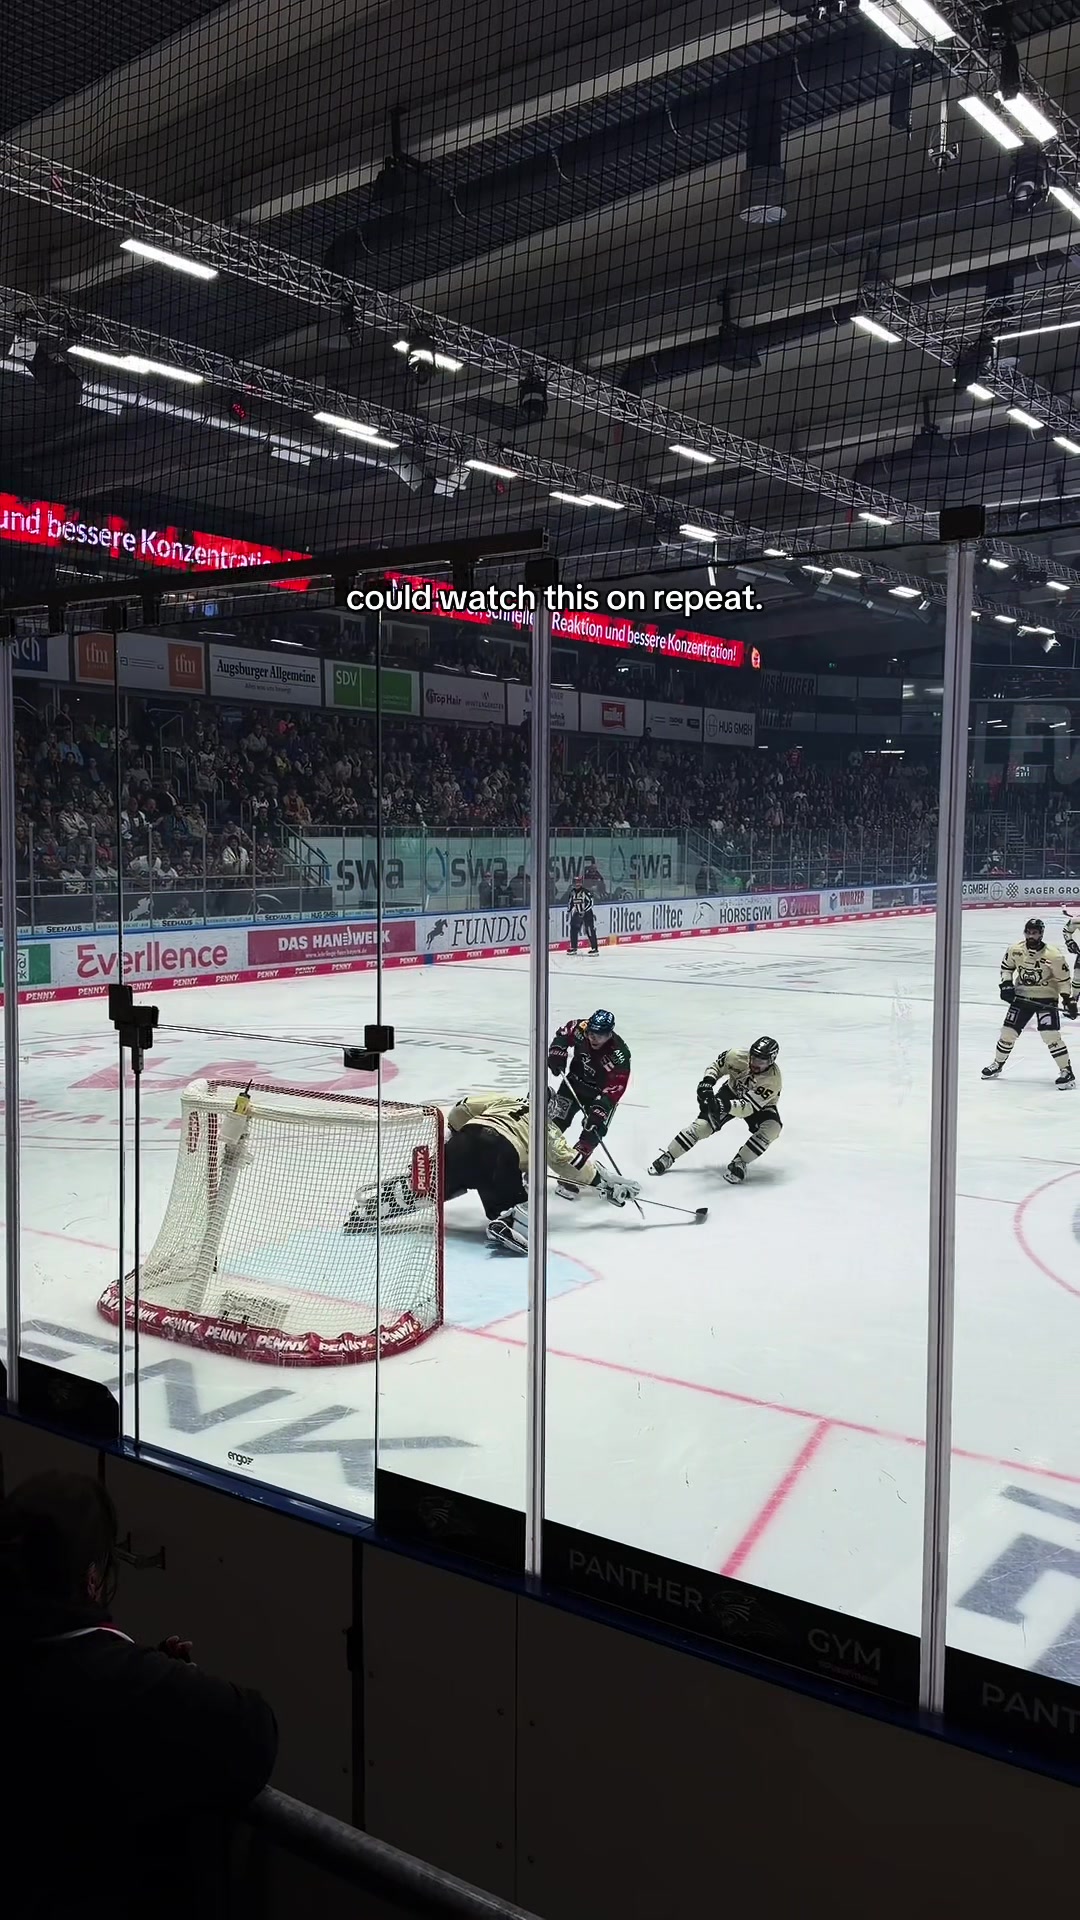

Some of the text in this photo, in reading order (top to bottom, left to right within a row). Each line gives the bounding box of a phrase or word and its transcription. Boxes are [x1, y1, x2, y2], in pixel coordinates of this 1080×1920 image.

[48, 510, 136, 551] bessere
[141, 529, 272, 569] Konzentrati
[551, 612, 603, 638] Reaktion
[605, 623, 625, 642] und
[627, 625, 666, 649] bessere
[667, 633, 737, 661] Konzentration!
[217, 659, 316, 683] Augsburger Allgemeine
[336, 669, 358, 686] SDV
[718, 720, 753, 736] HUG GMBH
[337, 857, 405, 891] swa
[451, 856, 508, 888] swa
[629, 853, 671, 880] swa
[968, 883, 989, 895] GMBH
[1024, 886, 1055, 895] SAGER
[162, 919, 193, 927] SEEHAUS
[719, 907, 752, 924] HORSE
[752, 905, 772, 921] GYM
[46, 925, 83, 934] SEEHAUS
[451, 915, 528, 946] FUNDIS
[278, 935, 308, 952] DAS
[77, 941, 228, 979] Everllence
[228, 1450, 249, 1466] engo
[568, 1548, 703, 1613] PANTHER
[807, 1628, 881, 1671] GYM
